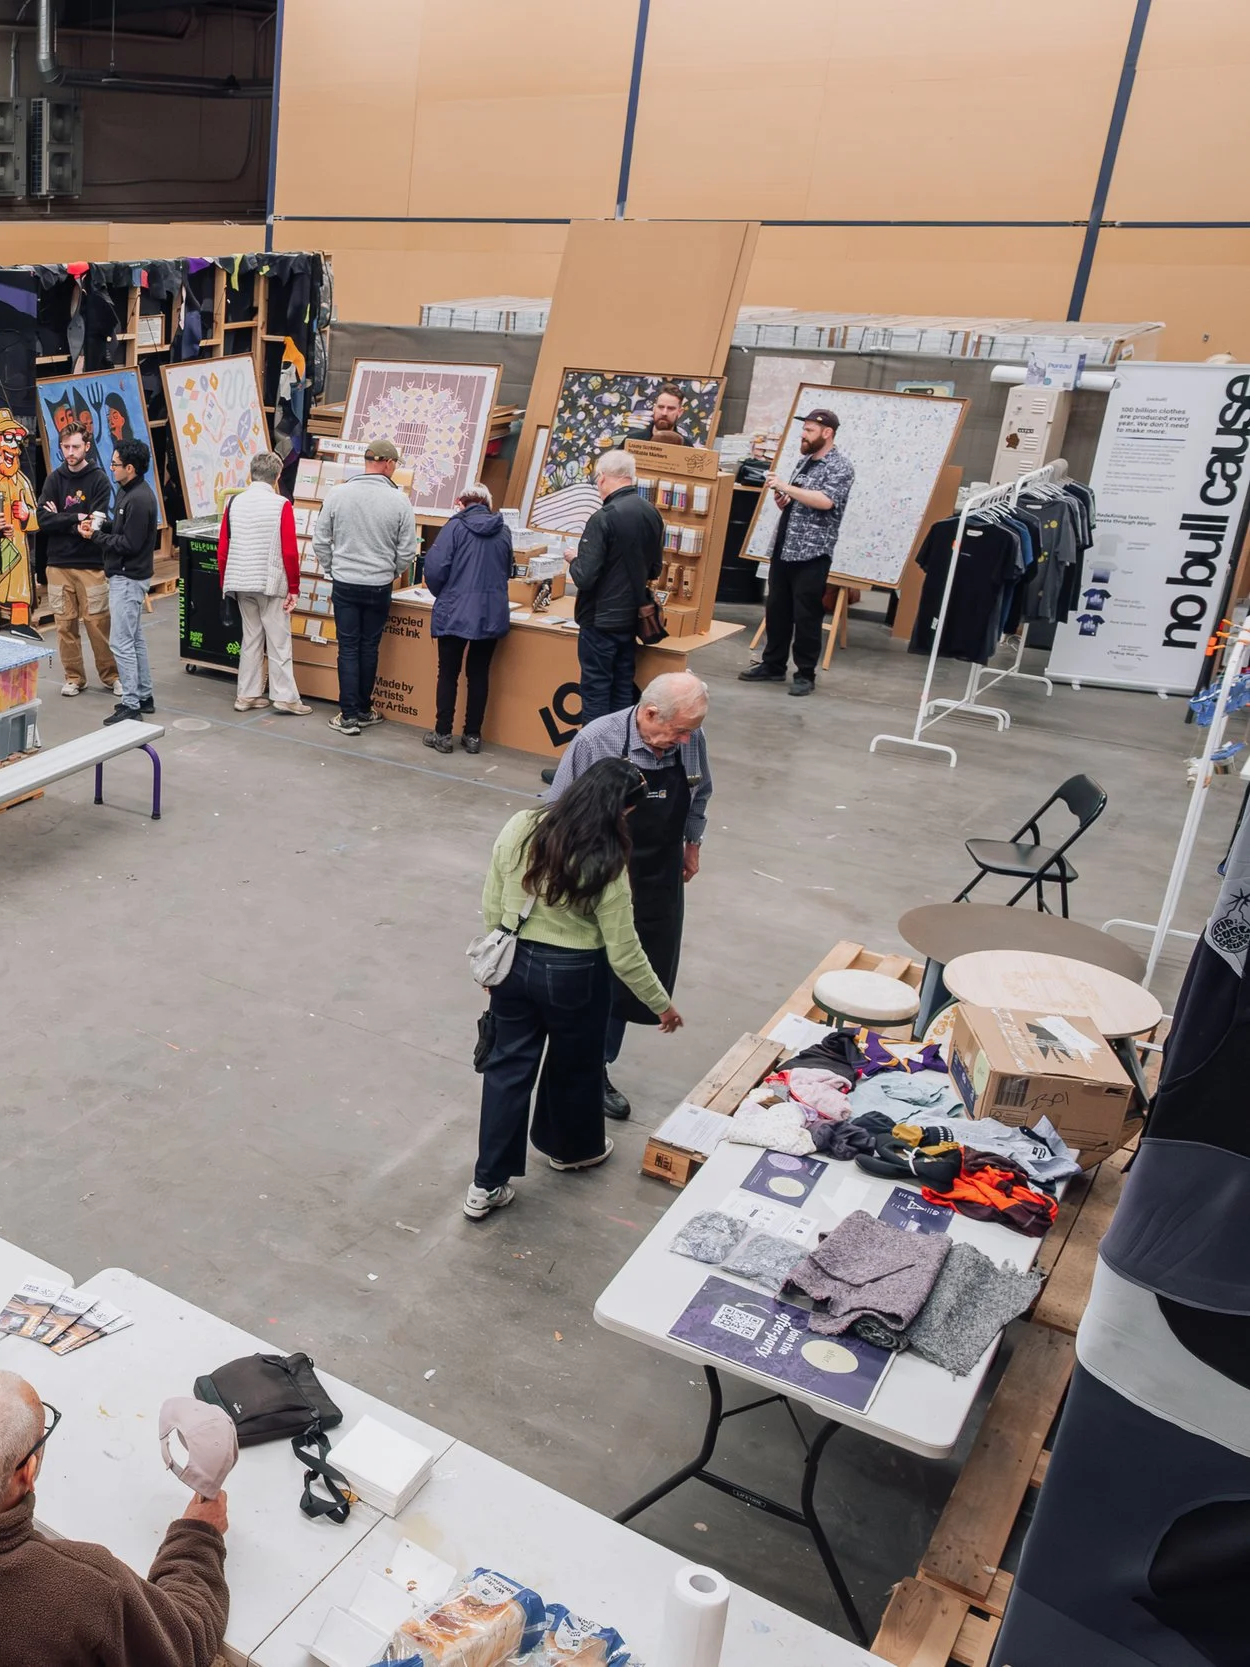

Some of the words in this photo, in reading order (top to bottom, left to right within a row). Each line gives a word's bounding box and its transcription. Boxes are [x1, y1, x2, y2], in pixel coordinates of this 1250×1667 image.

[1200, 374, 1250, 506] cause
[1165, 513, 1230, 587] bull
[386, 615, 423, 628] ecycled
[1162, 594, 1207, 649] no
[406, 628, 421, 639] Ink
[375, 676, 401, 690] Made
[402, 681, 414, 694] by
[373, 687, 405, 702] Artists
[386, 701, 419, 716] Artists
[1213, 919, 1234, 936] RIP
[755, 1313, 792, 1358] after-party.
[778, 1342, 793, 1355] the
